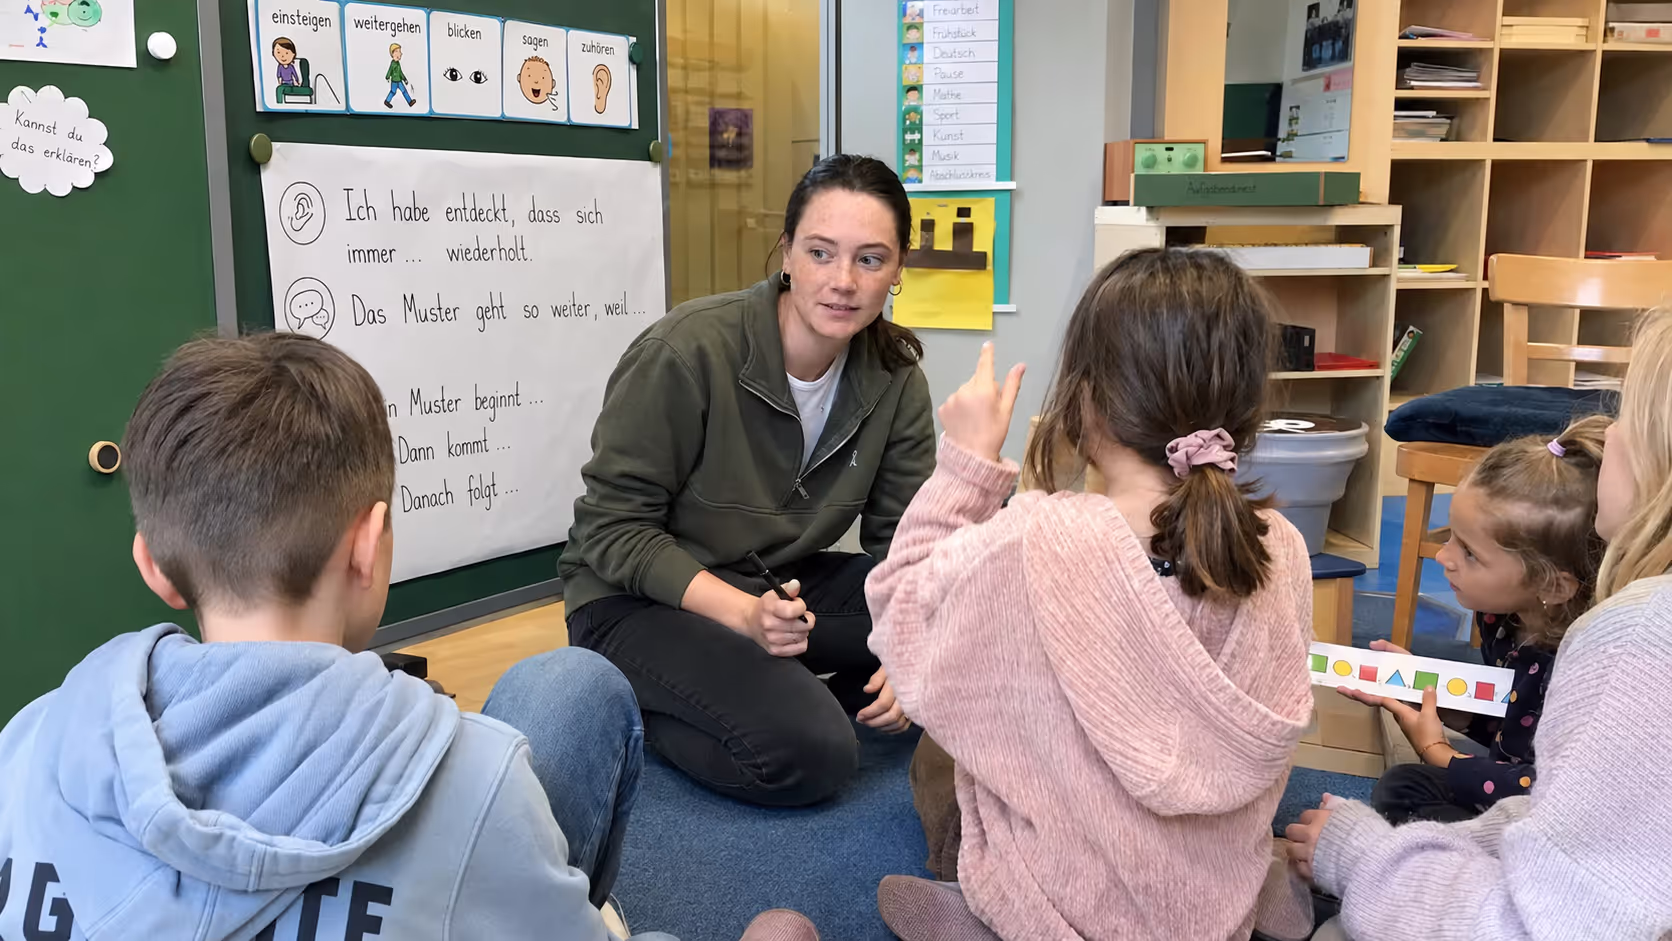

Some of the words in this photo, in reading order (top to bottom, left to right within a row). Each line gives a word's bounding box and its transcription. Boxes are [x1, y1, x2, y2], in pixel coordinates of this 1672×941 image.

[271, 9, 332, 33] einsteigen
[352, 15, 422, 38] weitergehen
[447, 22, 482, 41] blicken
[521, 35, 549, 52] sagen
[580, 40, 616, 56] zuhören
[933, 46, 976, 59] Deutsch
[934, 66, 965, 80] Pause
[14, 109, 57, 136] Kannst
[67, 127, 84, 143] du
[933, 107, 960, 124] Sport
[933, 128, 964, 141] Kunst
[10, 136, 35, 155] das
[931, 149, 960, 161] Musik
[342, 188, 378, 222] Ich
[390, 189, 431, 225] habe
[445, 192, 516, 228] entdeckt,
[527, 195, 561, 225] dass
[575, 198, 604, 225] sich
[346, 244, 397, 265] immer
[445, 235, 533, 266] wiederholt.
[350, 294, 387, 327] Das
[402, 293, 461, 325] Muster
[475, 291, 508, 334] geht
[522, 305, 540, 323] so
[549, 291, 598, 322] weiter,
[409, 386, 462, 417] Muster
[474, 381, 522, 423] beginnt
[396, 436, 435, 467] Dann
[446, 427, 490, 459] kommt
[398, 479, 455, 514] Danach
[466, 472, 499, 512] folgt
